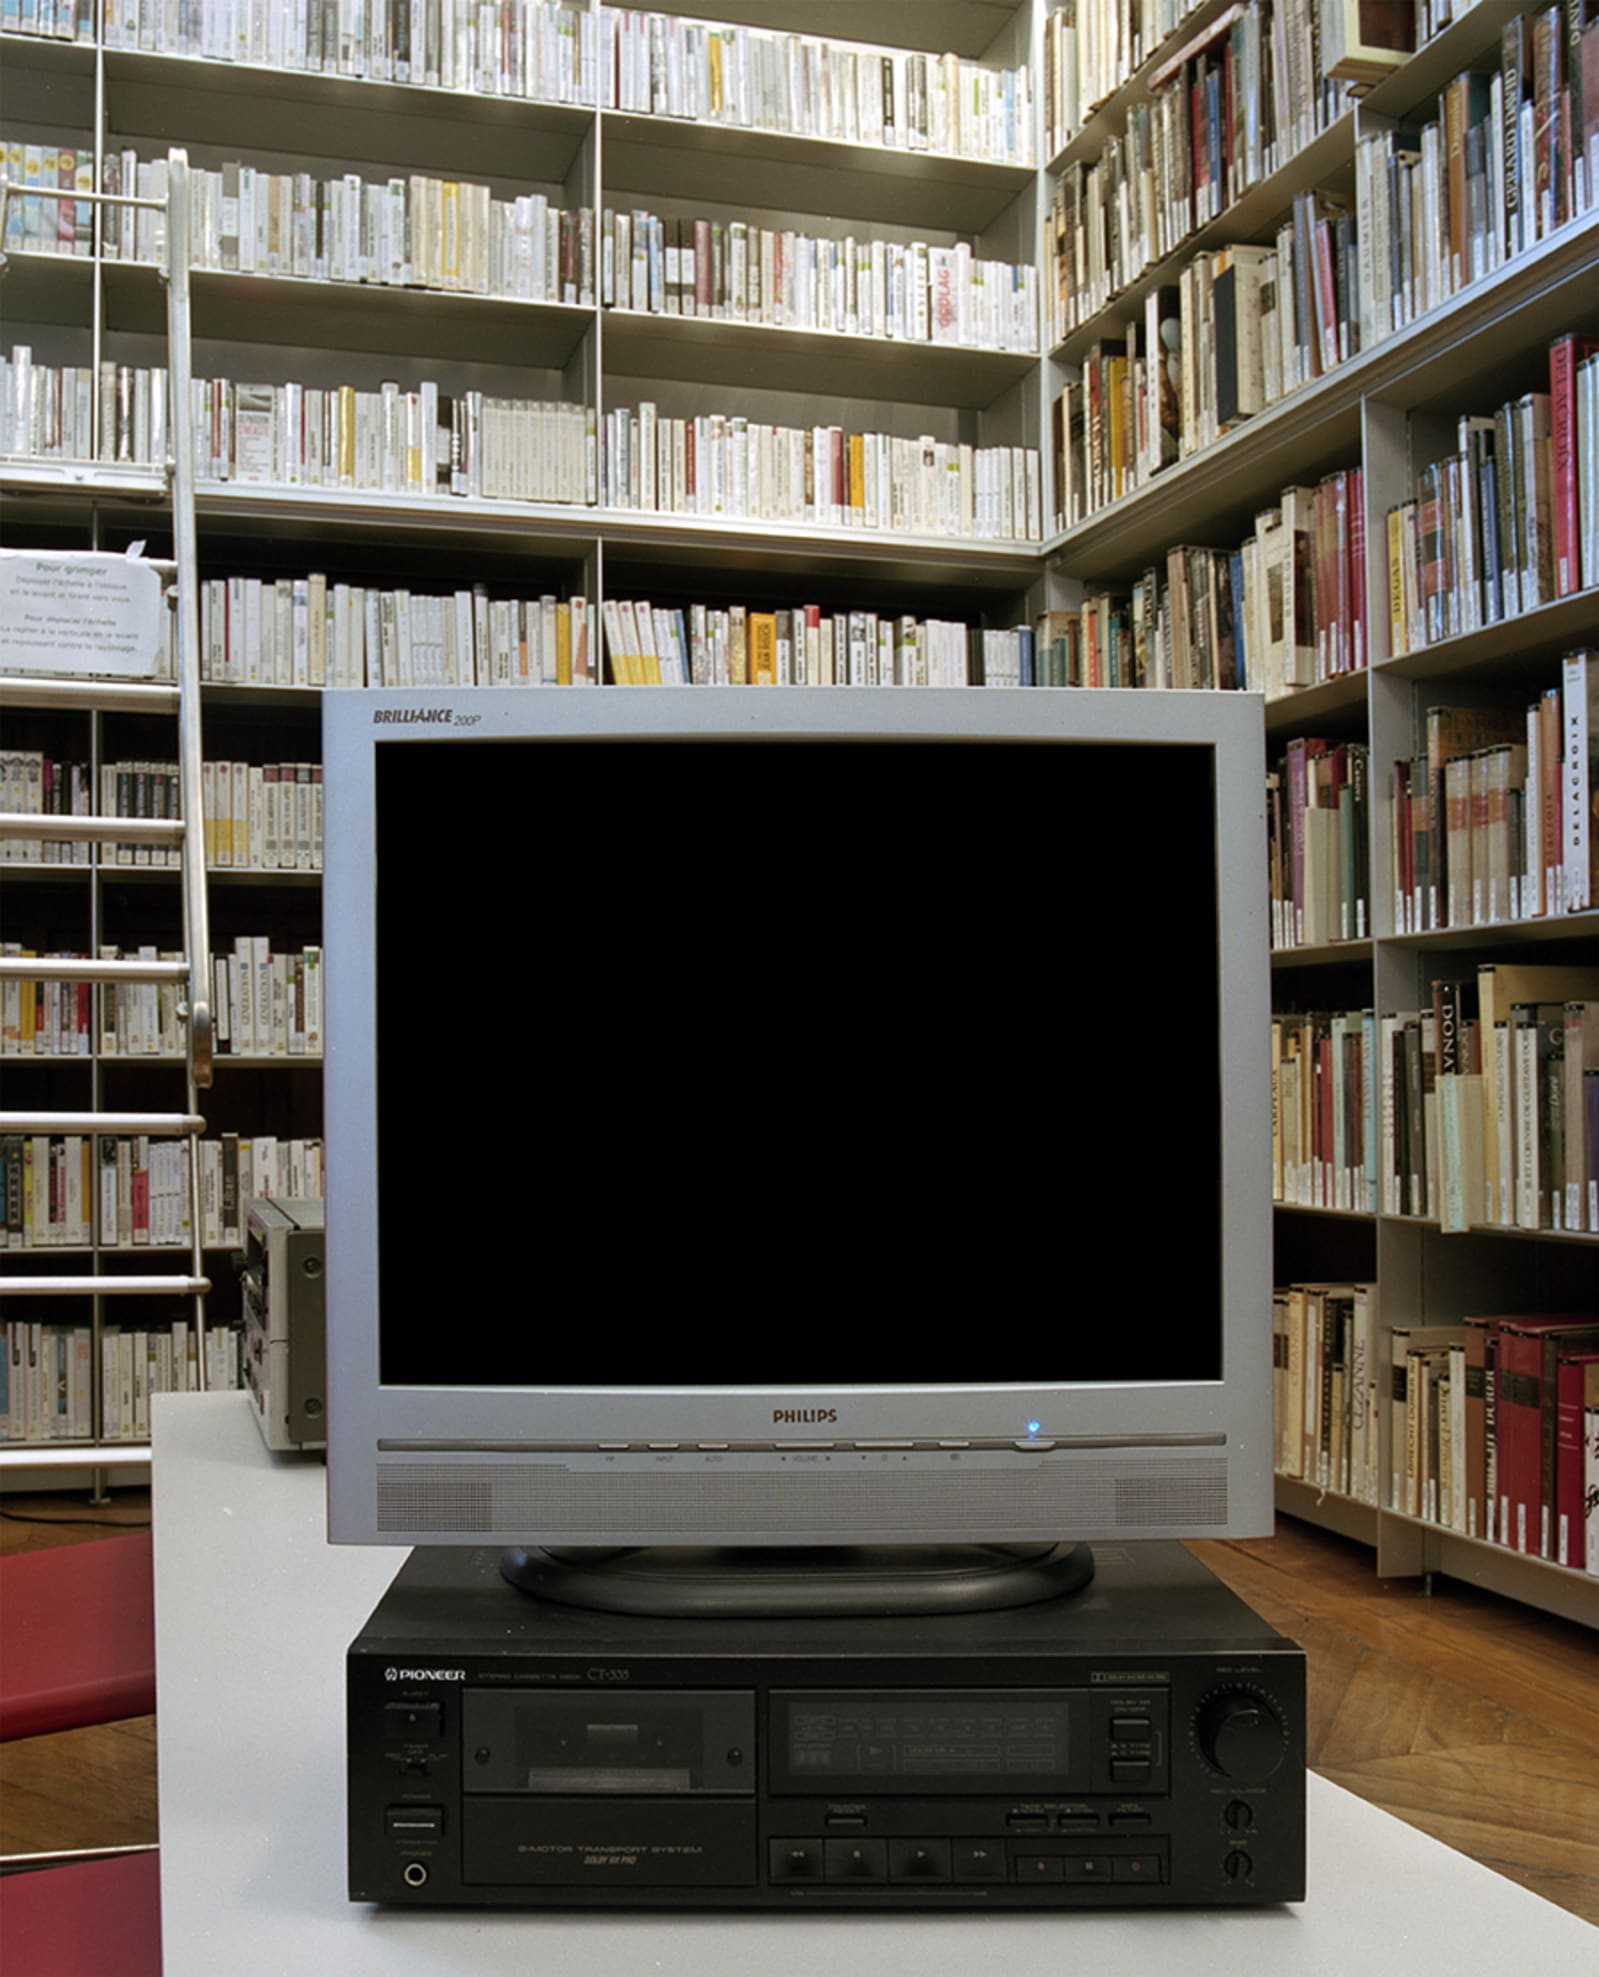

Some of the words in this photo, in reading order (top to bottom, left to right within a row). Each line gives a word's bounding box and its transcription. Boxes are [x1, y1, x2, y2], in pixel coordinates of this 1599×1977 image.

[1556, 347, 1569, 473] DELACROIX
[36, 561, 60, 571] Pour
[64, 564, 107, 577] grimper
[373, 706, 453, 724] BRILLIANCE
[1571, 716, 1580, 847] DELACROIX
[773, 1408, 838, 1423] PHILIPS
[400, 1670, 466, 1680] PIONEER
[651, 1845, 704, 1853] SYSTEM
